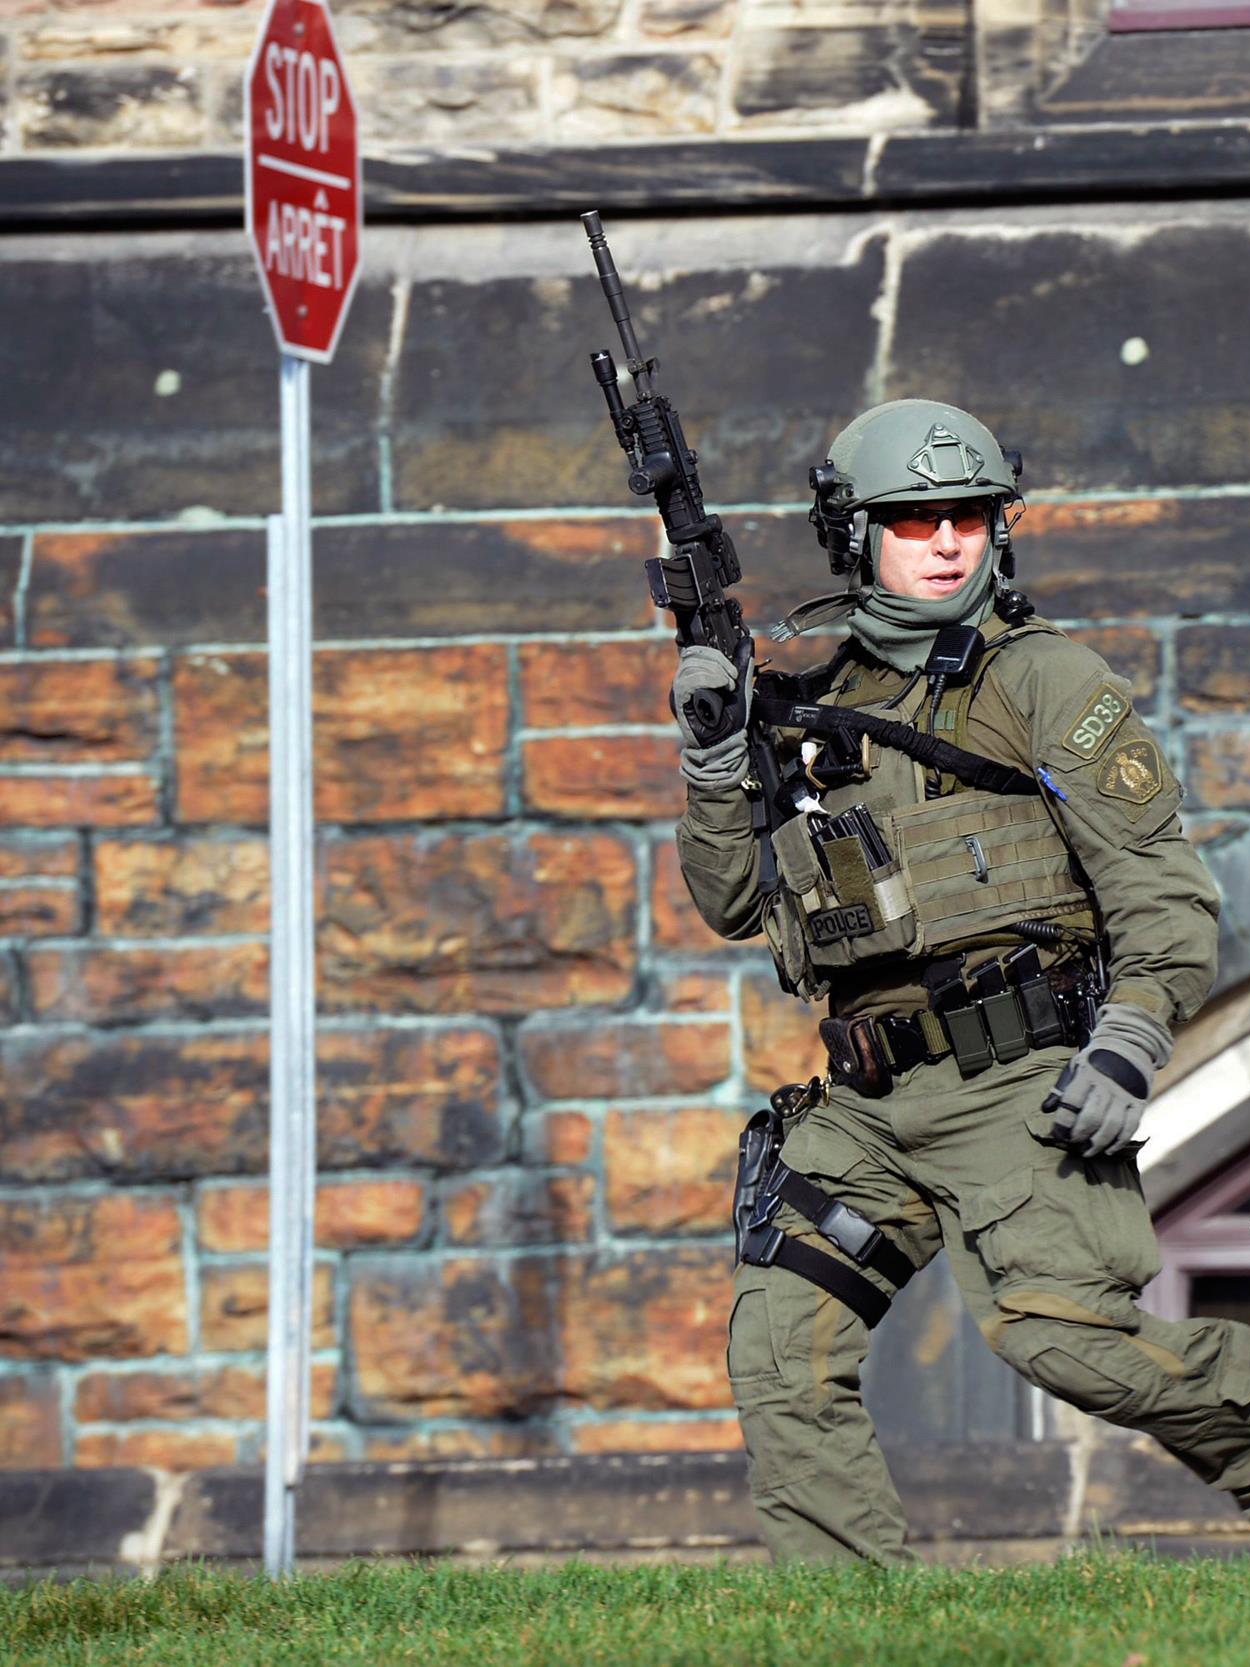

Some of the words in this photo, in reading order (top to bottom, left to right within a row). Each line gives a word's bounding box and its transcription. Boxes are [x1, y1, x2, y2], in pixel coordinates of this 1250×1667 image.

[265, 42, 340, 153] STOP
[265, 188, 346, 290] ARRÊT
[1072, 694, 1121, 750] SD38
[813, 909, 870, 939] POLICE
